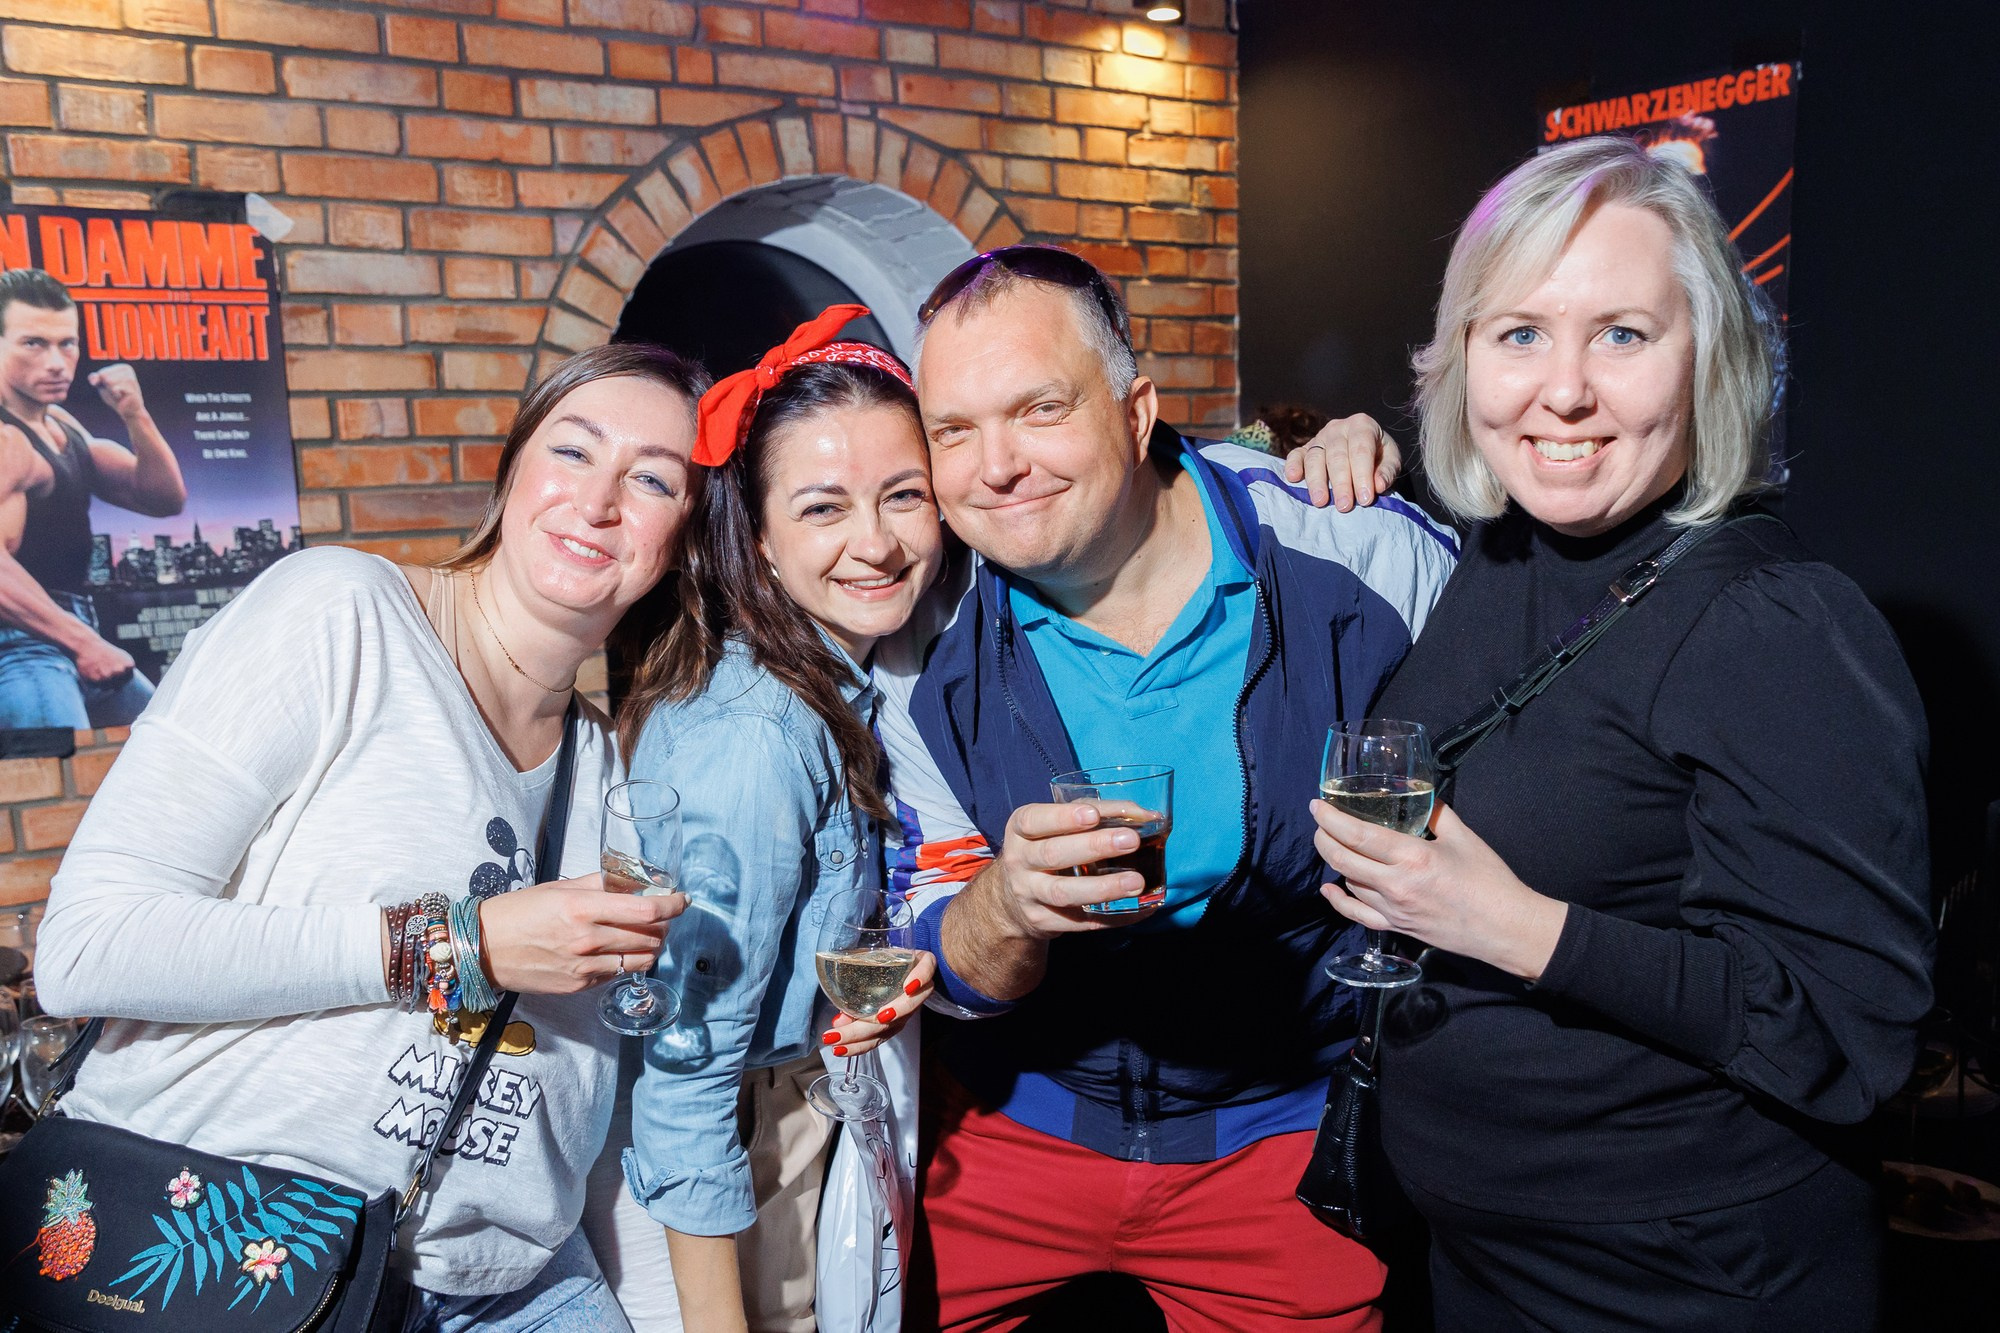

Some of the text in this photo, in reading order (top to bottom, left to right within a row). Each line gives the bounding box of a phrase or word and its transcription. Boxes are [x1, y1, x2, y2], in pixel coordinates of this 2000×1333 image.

[1544, 63, 1793, 142] SCHWARZENEGGER
[38, 215, 268, 290] DAMME
[83, 303, 270, 361] LIONHEART
[373, 1095, 520, 1167] MOUSE
